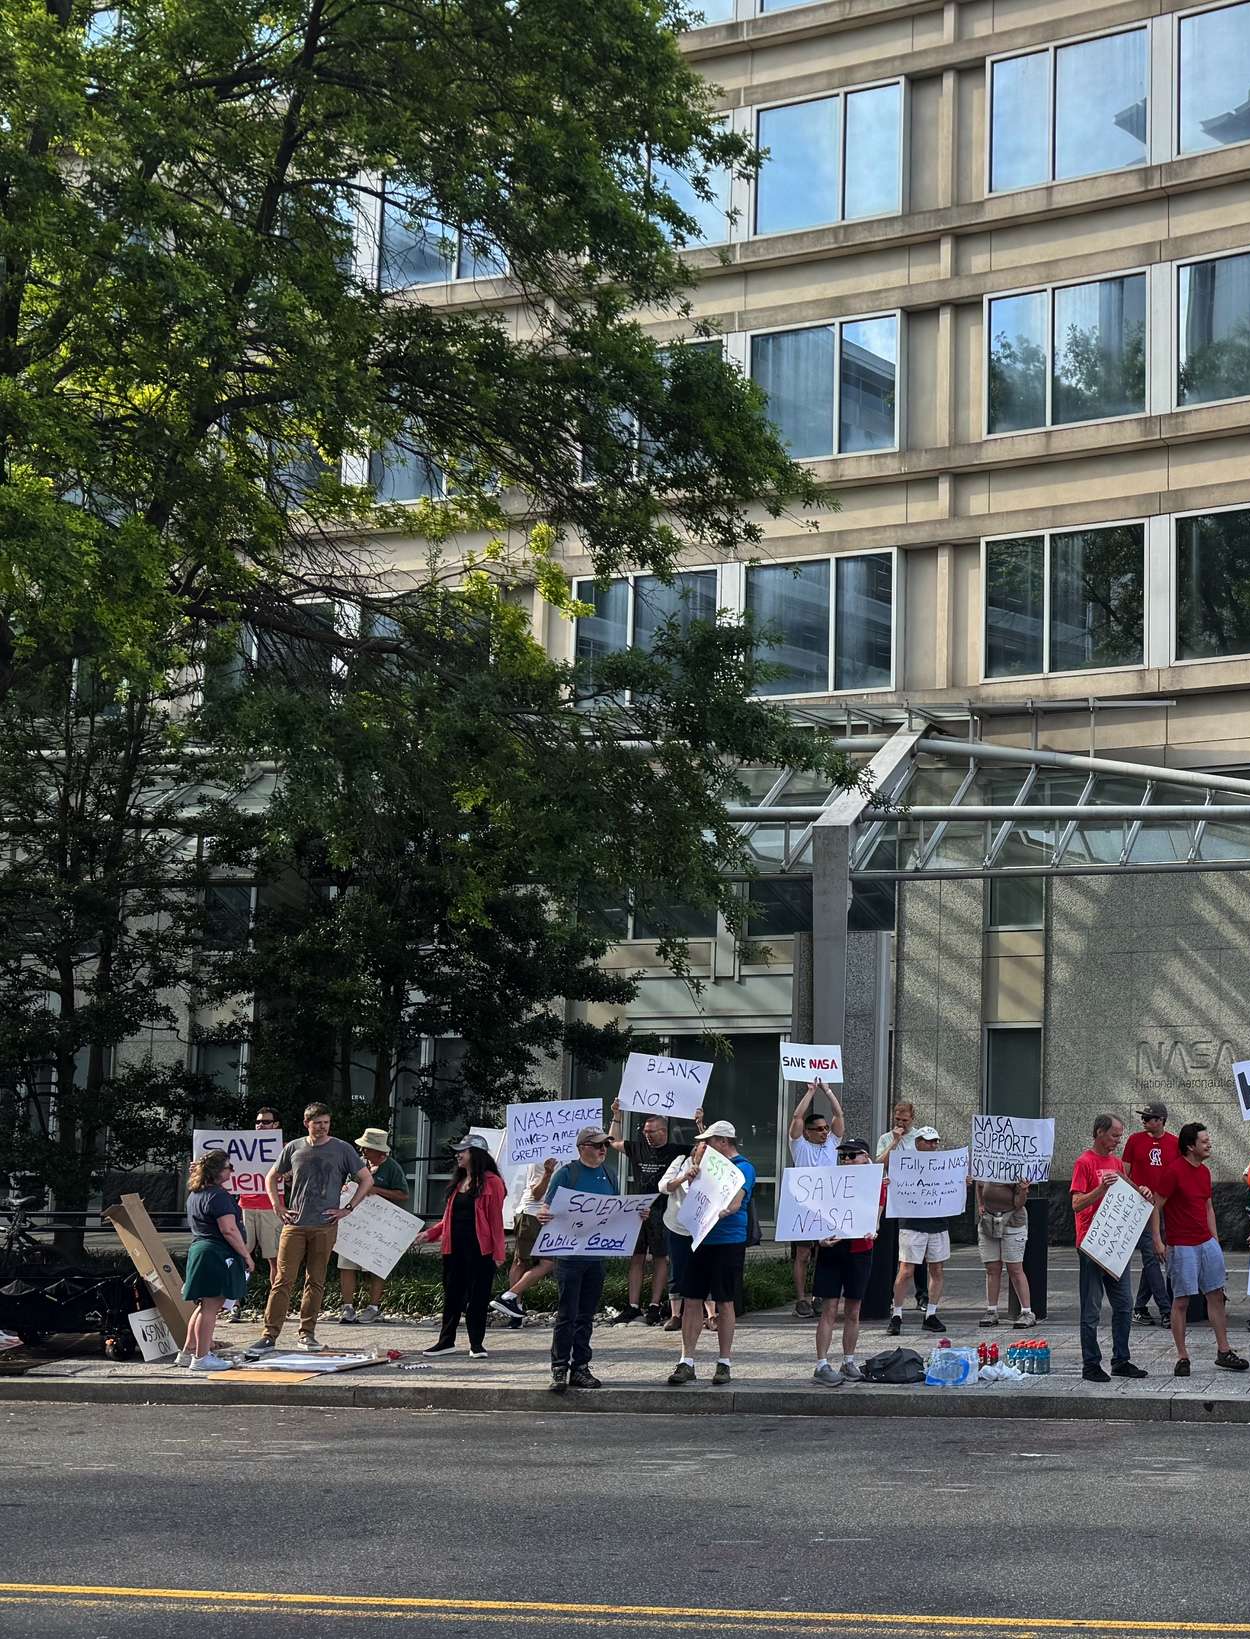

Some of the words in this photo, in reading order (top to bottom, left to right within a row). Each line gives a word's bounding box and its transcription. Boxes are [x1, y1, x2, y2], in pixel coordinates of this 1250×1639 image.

[783, 1056, 806, 1068] SAVE
[809, 1059, 838, 1069] NASA
[1136, 1040, 1238, 1077] NASA
[647, 1058, 701, 1083] BLANK
[514, 1111, 554, 1132] NASA
[557, 1108, 603, 1123] SCIENCE
[974, 1116, 1014, 1135] NASA
[515, 1132, 549, 1149] MAKES
[974, 1132, 1038, 1154] SUPPORTS
[512, 1147, 545, 1161] GREAT
[901, 1157, 924, 1174] Fully
[973, 1158, 984, 1178] SO
[987, 1160, 1025, 1181] SUPPORT
[795, 1175, 855, 1203] SAVE
[568, 1194, 653, 1216] SCIENCE
[792, 1208, 853, 1233] NASA
[1087, 1220, 1101, 1245] HOW
[1100, 1192, 1114, 1218] DOES
[1098, 1193, 1125, 1247] GUTTING
[1105, 1223, 1124, 1257] NASA
[1121, 1193, 1136, 1222] HELP
[538, 1233, 578, 1249] Public
[587, 1233, 627, 1248] Good
